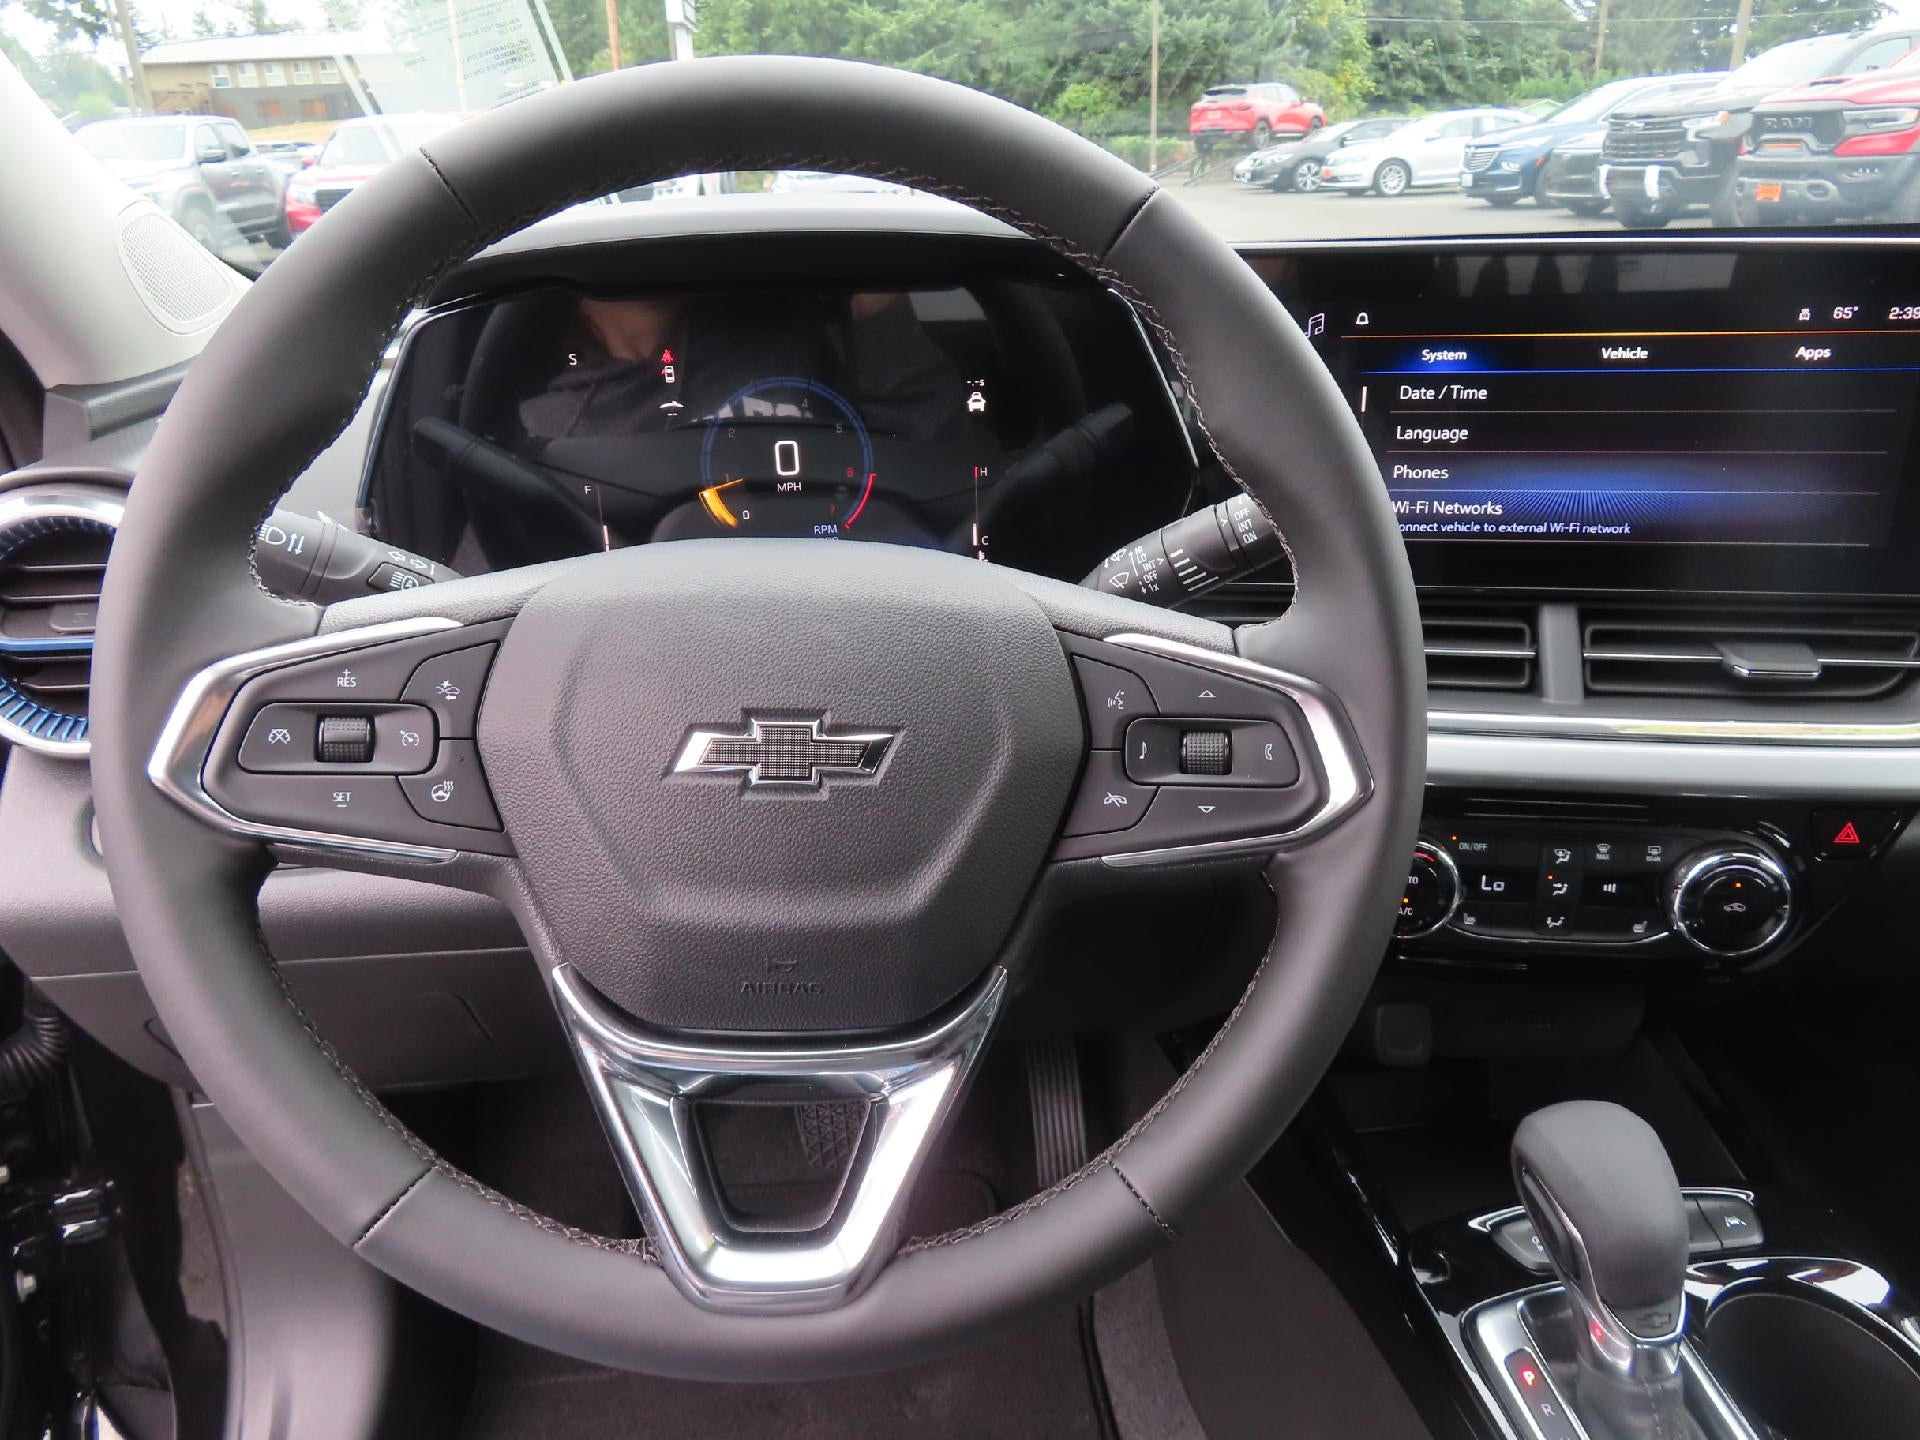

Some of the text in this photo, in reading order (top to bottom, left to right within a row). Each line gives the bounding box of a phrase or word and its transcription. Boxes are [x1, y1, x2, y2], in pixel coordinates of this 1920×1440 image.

[1833, 306, 1859, 320] 65°
[568, 353, 578, 366] S
[1421, 347, 1467, 364] System
[1601, 346, 1648, 360] Vehicle
[1796, 345, 1831, 360] Apps
[1400, 384, 1488, 401] Date / Time
[1396, 424, 1468, 444] Language
[775, 440, 800, 476] 0
[1393, 464, 1449, 480] Phones
[777, 482, 802, 492] MPH
[1234, 508, 1251, 521] OFF
[1392, 500, 1502, 515] Wi-Fi Networks
[814, 524, 838, 535] RPM
[1237, 519, 1253, 533] INT
[1399, 521, 1631, 534] onnect vehicle to external Wi-Fi network
[1242, 531, 1258, 544] ON
[333, 791, 352, 802] SET
[1458, 841, 1488, 852] ON/OFF
[740, 981, 822, 995] AIRBAG
[1522, 1370, 1535, 1386] P
[1540, 1403, 1556, 1417] R
